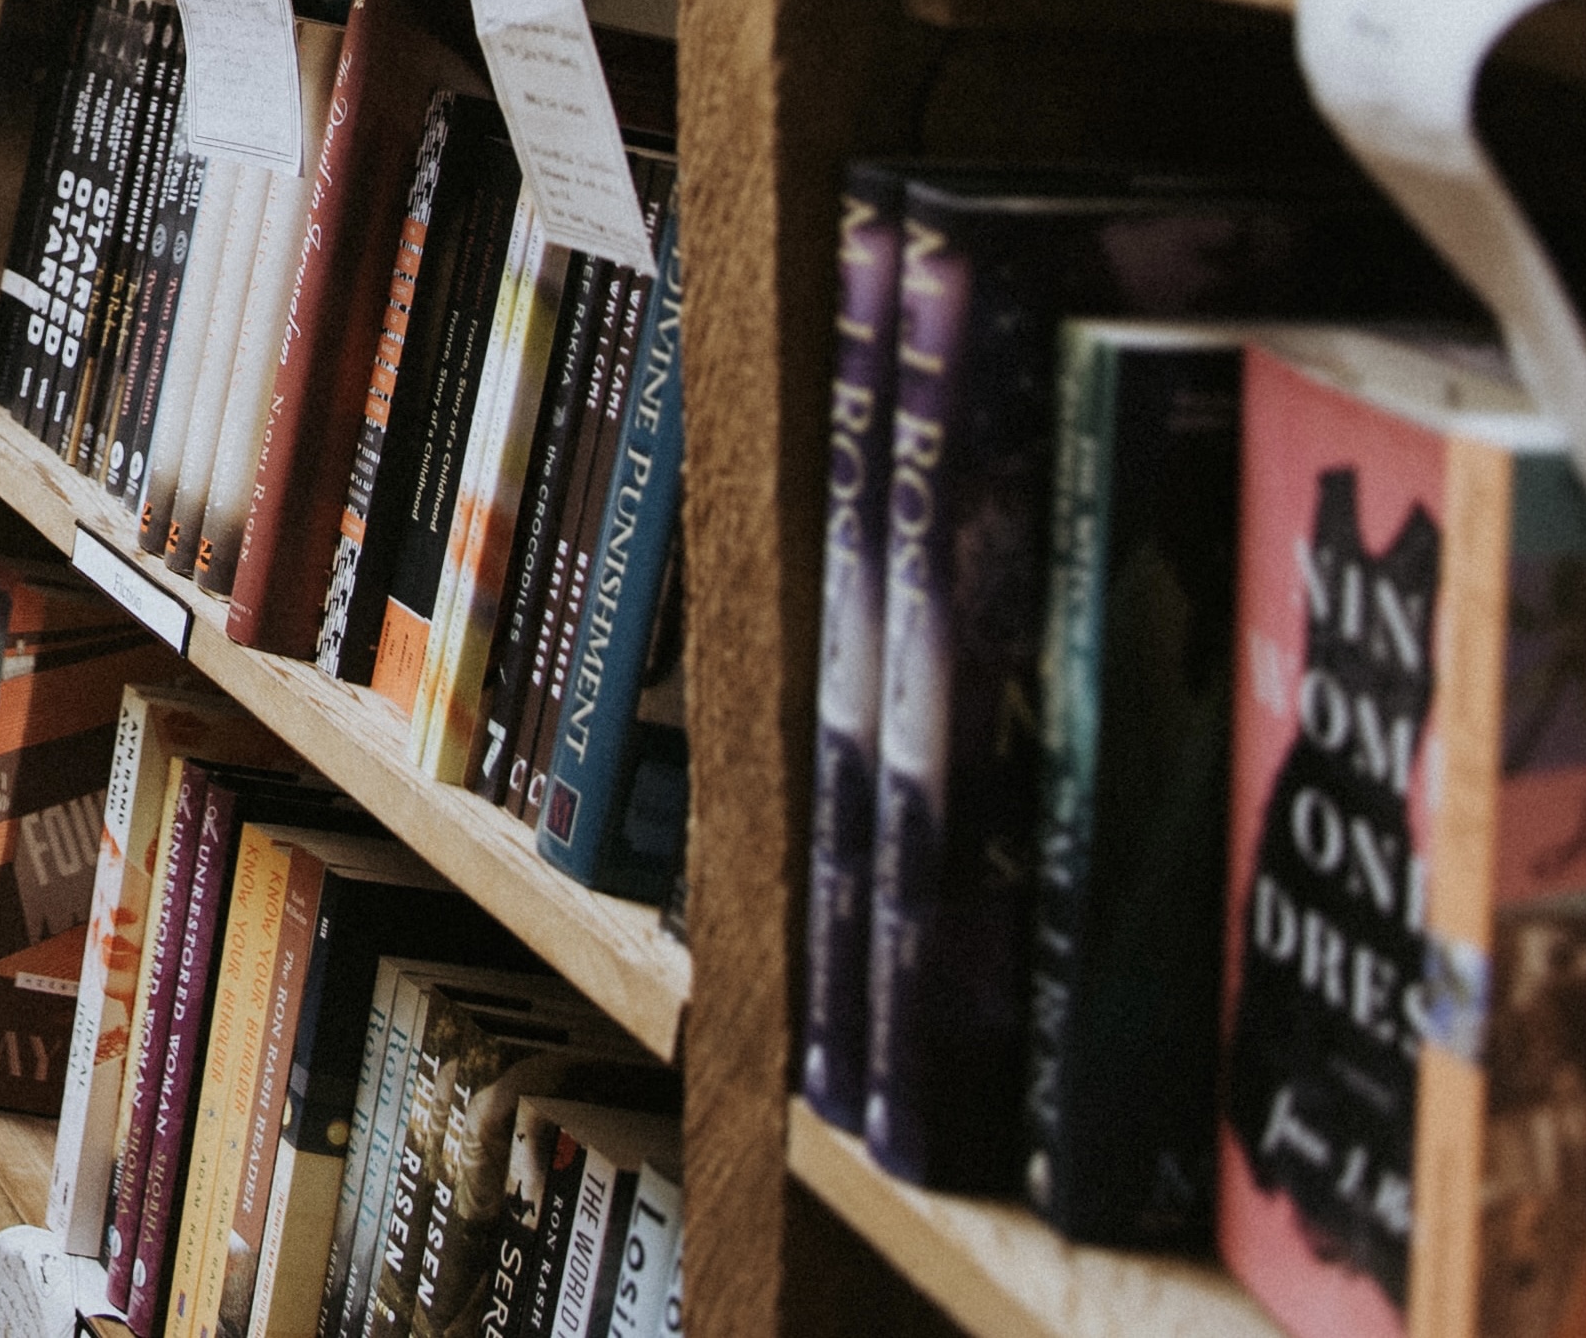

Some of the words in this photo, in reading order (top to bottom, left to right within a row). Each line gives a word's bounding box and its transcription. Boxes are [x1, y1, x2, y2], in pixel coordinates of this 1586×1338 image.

[135, 58, 147, 86] THE
[153, 61, 167, 90] THE
[167, 67, 180, 97] THE
[337, 51, 353, 88] The
[104, 91, 141, 237] IMPERFECTIONISTS
[122, 96, 160, 243] IMPERFECTIONISTS
[135, 101, 174, 251] IMPERFECTIONISTS
[318, 96, 348, 187] Devil
[311, 180, 326, 210] in
[839, 196, 878, 264] M
[27, 169, 76, 346] OTARED
[44, 177, 93, 356] OTARED
[61, 187, 110, 368] OTARED
[280, 213, 323, 366] Jerusalem
[900, 218, 946, 300] M
[140, 269, 158, 321] Tom
[162, 276, 179, 321] Tom
[601, 280, 621, 330] WHY
[620, 289, 642, 339] WHY
[120, 320, 147, 416] Rachman
[444, 309, 460, 364] France,
[460, 318, 478, 373] France,
[561, 302, 587, 386] RAKHA
[140, 328, 169, 425] Rachman
[433, 367, 448, 408] Story
[451, 377, 468, 417] Story
[585, 352, 605, 409] CAME
[605, 362, 626, 421] CAME
[258, 393, 285, 472] NAOMI
[428, 409, 439, 431] of
[448, 418, 459, 440] of
[411, 442, 434, 521] Childhood
[429, 452, 452, 532] Childhood
[544, 445, 557, 478] the
[826, 375, 875, 592] ROSE
[237, 483, 266, 563] RAGEN
[886, 405, 944, 624] ROSE
[510, 484, 550, 643] CROCODILES
[547, 538, 568, 599] MARY
[568, 551, 589, 614] MARY
[565, 445, 653, 765] PUNISHMENT
[1296, 538, 1420, 670] NIN
[532, 608, 554, 687] RAKOW
[551, 621, 575, 701] RAKOW
[119, 707, 130, 748] AYN
[126, 719, 140, 765] AYN
[109, 754, 123, 811] RAND
[116, 769, 133, 826] RAND
[149, 820, 184, 997] UNRESTORED
[238, 843, 261, 908] KNOW
[261, 869, 284, 939] KNOW
[174, 844, 211, 1021] UNRESTORED
[226, 919, 249, 981] YOUR
[282, 949, 295, 981] The
[251, 949, 272, 1011] YOUR
[270, 983, 288, 1040] RON
[78, 1018, 96, 1087] IDEAL
[132, 1008, 156, 1110] WOMAN
[210, 988, 236, 1085] BEHOLDER
[236, 1016, 259, 1116] BEHOLDER
[358, 1005, 387, 1087] Ron
[380, 1025, 409, 1107] Ron
[155, 1034, 182, 1136] WOMAN
[257, 1044, 280, 1111] RASH
[411, 1051, 441, 1132] THE
[339, 1106, 369, 1207] Rash
[442, 1082, 472, 1159] THE
[118, 1126, 143, 1215] SHOBHA
[143, 1151, 167, 1244] SHOBHA
[194, 1153, 207, 1209] ADAM
[241, 1112, 267, 1215] READER
[360, 1127, 391, 1229] Rash
[578, 1171, 607, 1229] THE
[215, 1184, 230, 1243] ADAM
[384, 1145, 423, 1273] RISEN
[416, 1178, 454, 1307] RISEN
[546, 1193, 564, 1251] RON
[182, 1222, 197, 1275] RAPP
[205, 1256, 220, 1311] RAPP
[326, 1240, 340, 1298] ABOVE
[559, 1231, 595, 1334] WORLD
[345, 1263, 360, 1315] ABOVE
[530, 1258, 553, 1331] RASH
